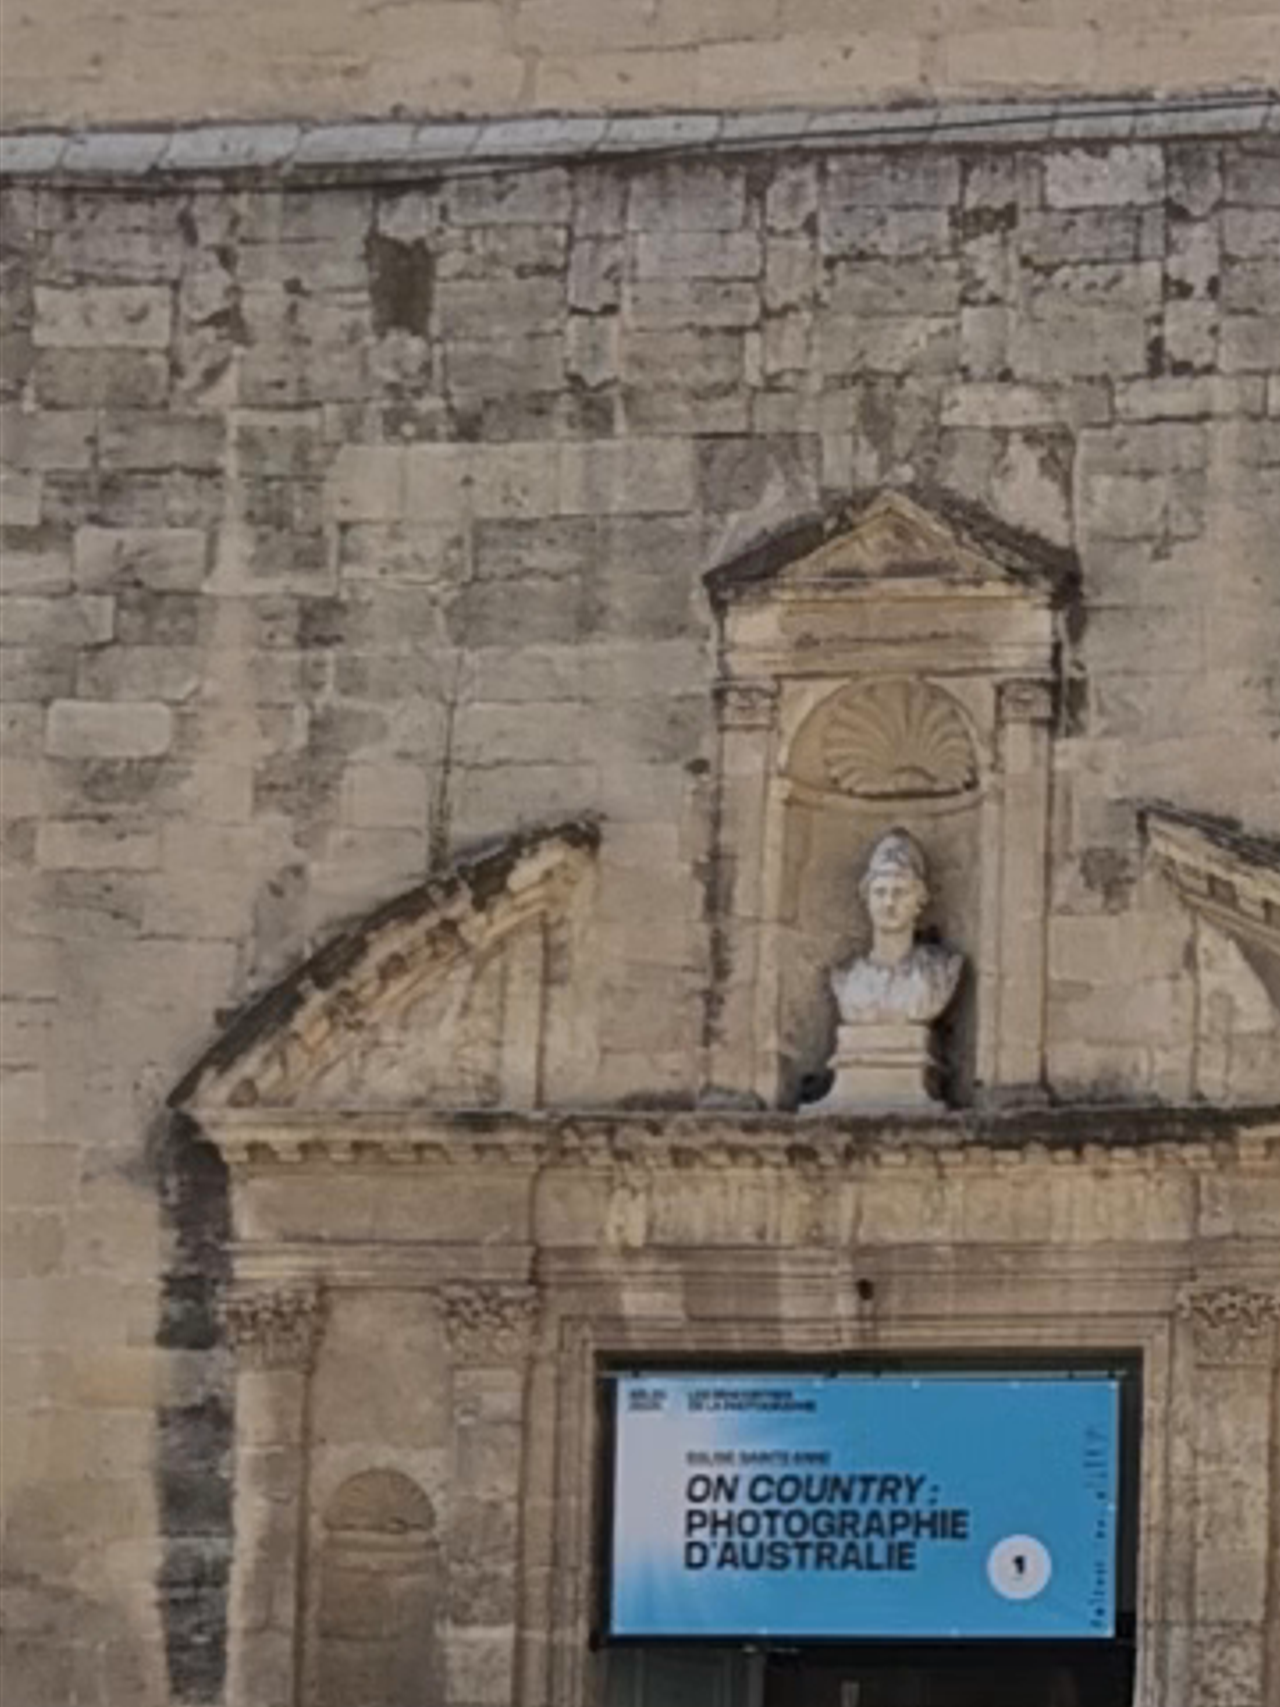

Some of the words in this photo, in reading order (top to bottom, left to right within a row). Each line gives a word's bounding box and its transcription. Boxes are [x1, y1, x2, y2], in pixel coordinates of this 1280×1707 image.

[685, 1474, 740, 1504] ON
[748, 1474, 927, 1504] COUNTRY
[684, 1509, 970, 1540] PHOTOGRAPHIE
[684, 1541, 918, 1571] D'AUSTRALIE
